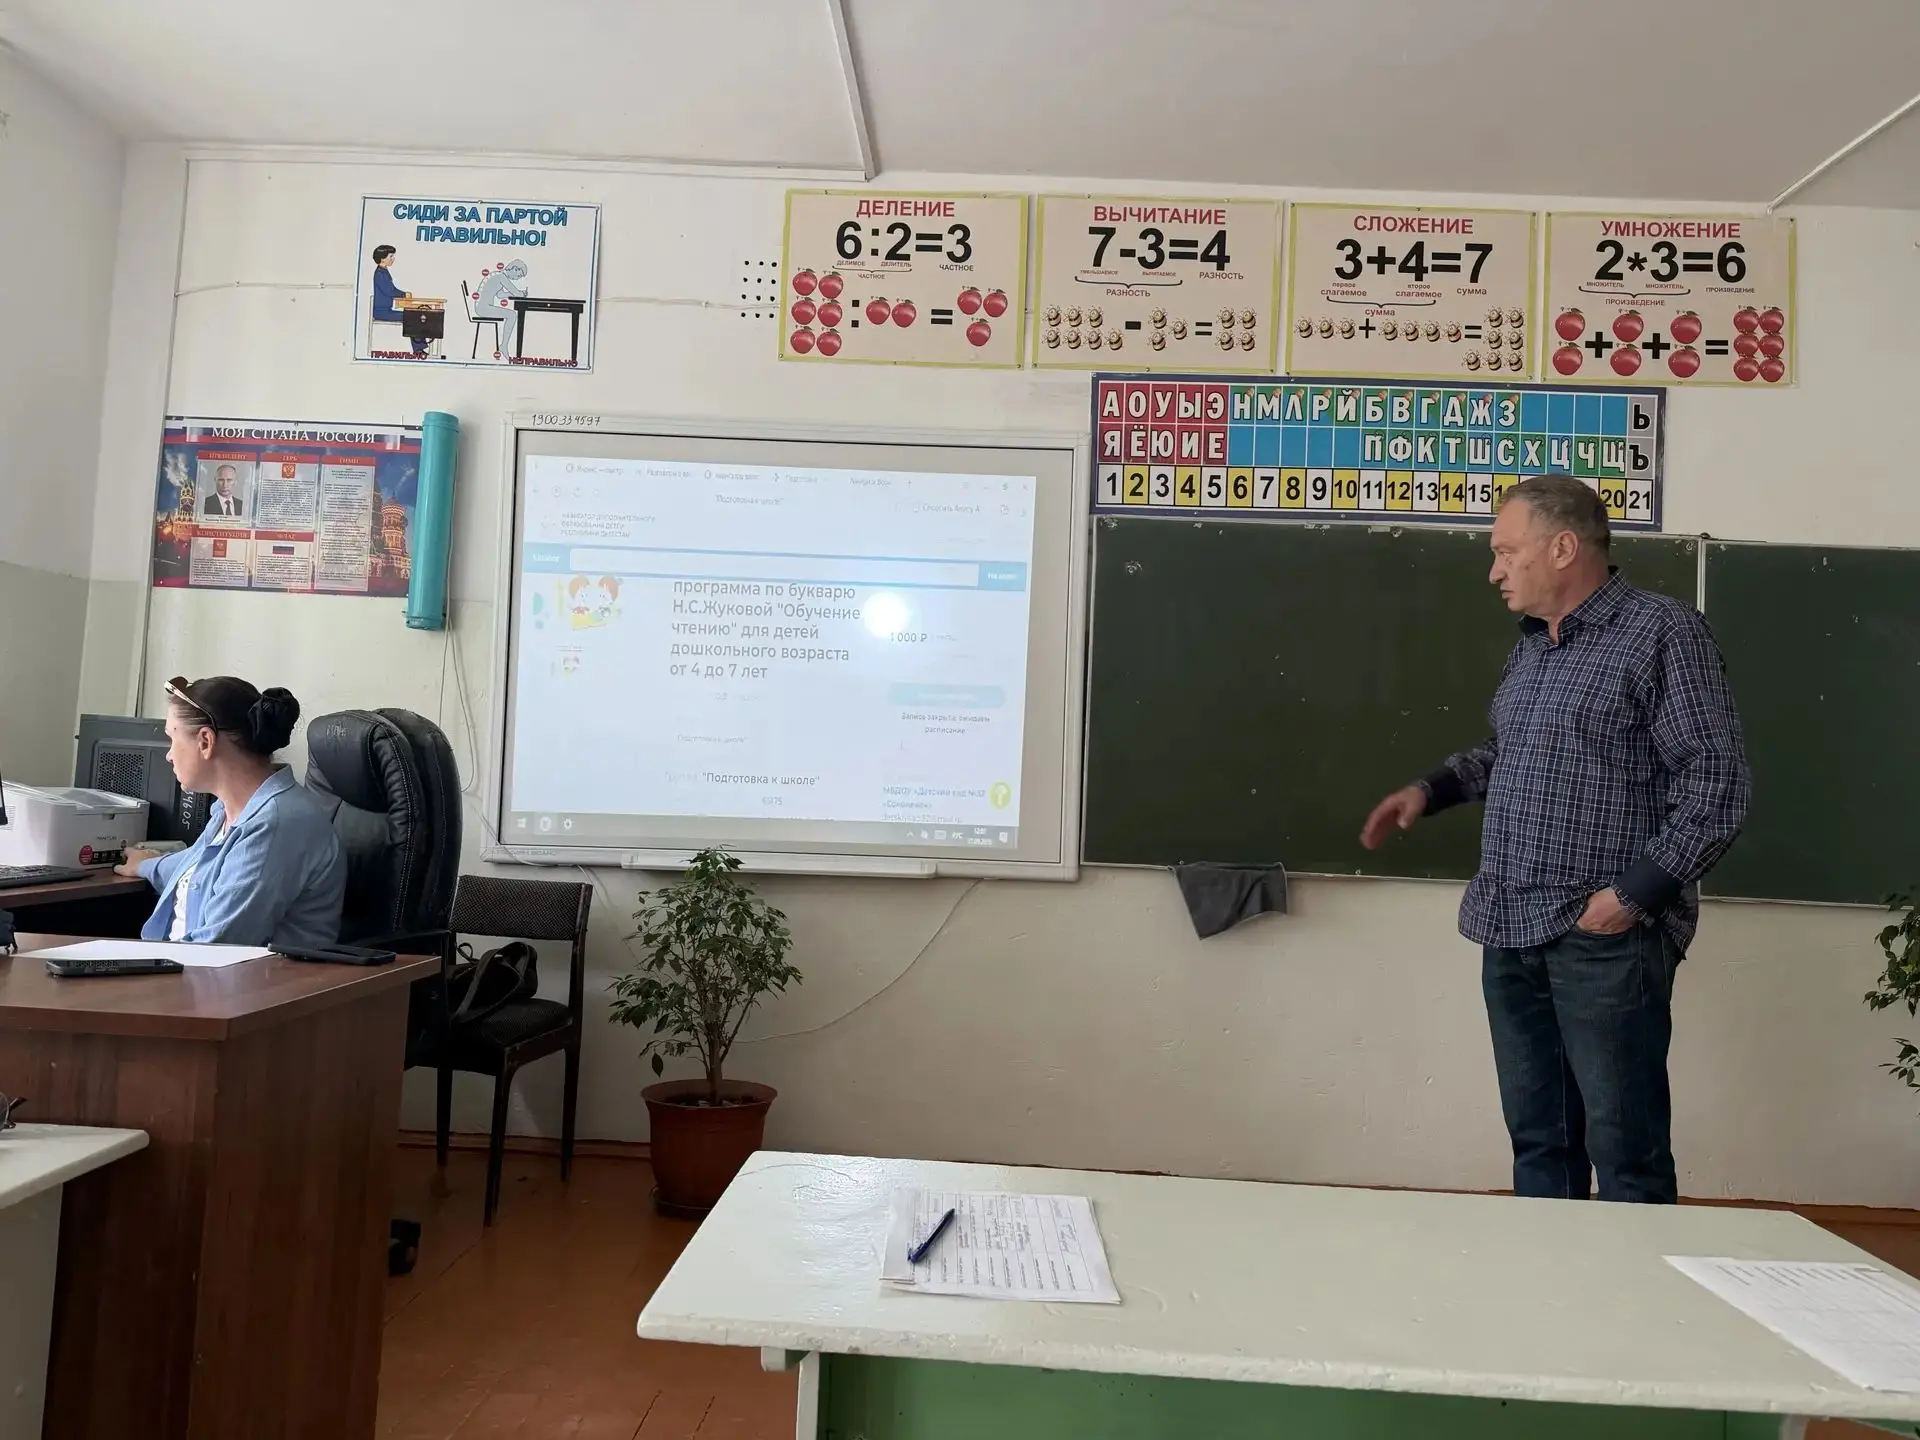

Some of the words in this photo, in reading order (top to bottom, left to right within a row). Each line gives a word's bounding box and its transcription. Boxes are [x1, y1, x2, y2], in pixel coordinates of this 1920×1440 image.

[393, 204, 448, 223] СИДИ
[454, 206, 480, 223] ЗА
[486, 207, 568, 226] ПАРТОЙ
[856, 200, 955, 218] ДЕЛЕНИЕ
[1094, 206, 1226, 225] ВЫЧИТАНИЕ
[1354, 215, 1474, 234] СЛОЖЕНИЕ
[1601, 220, 1740, 239] УМНОЖЕНИЕ
[416, 226, 547, 246] ПРАВИЛЬНО!
[1200, 272, 1244, 280] РАЗНОСТЬ
[1106, 289, 1151, 297] РАЗНОСТЬ
[1320, 288, 1367, 297] слагаемое
[1396, 290, 1442, 299] слагаемое
[1457, 288, 1487, 296] сумма
[1605, 298, 1665, 306] ПРОИЗВЕДЕНИЕ
[1365, 308, 1395, 316] сумма
[370, 351, 428, 361] ПРАВИЛЬНО
[509, 357, 578, 368] НЕПРАВИЛЬНО
[1102, 390, 1120, 418] А
[1128, 390, 1147, 418] О
[1155, 392, 1173, 418] У
[1178, 392, 1201, 419] Ы
[1207, 392, 1225, 419] Э
[1233, 393, 1251, 420] Н
[1256, 393, 1280, 420] М
[1284, 393, 1303, 421] Л
[1311, 393, 1329, 422] Р
[1336, 389, 1356, 422] Й
[1364, 396, 1384, 422] Б
[1392, 396, 1410, 423] В
[1420, 397, 1436, 424] Г
[1443, 396, 1464, 427] Д
[1470, 398, 1492, 426] Ж
[1498, 400, 1516, 427] З
[1633, 404, 1651, 430] Ь
[212, 427, 246, 439] МОЯ
[251, 429, 309, 441] СТРАНА
[316, 431, 376, 443] РОССИЯ
[1103, 431, 1121, 457] Я
[1130, 424, 1147, 457] Ё
[1151, 431, 1174, 457] Ю
[1181, 432, 1200, 459] И
[1208, 432, 1224, 459] Е
[1364, 433, 1382, 461] П
[1388, 436, 1412, 462] Ф
[1417, 437, 1436, 464] К
[1444, 437, 1461, 464] Т
[1469, 437, 1491, 465] Ш
[1497, 439, 1516, 466] С
[1523, 439, 1542, 467] Х
[1551, 440, 1570, 470] Ц
[1577, 440, 1595, 469] Ч
[1602, 441, 1625, 473] Щ
[1629, 444, 1649, 470] Ъ
[1106, 473, 1117, 496] 1
[1129, 473, 1143, 497] 2
[1155, 474, 1169, 497] 3
[1180, 475, 1195, 498] 4
[1207, 475, 1221, 498] 5
[1233, 475, 1247, 499] 6
[1260, 476, 1275, 499] 7
[1286, 476, 1300, 500] 8
[1312, 477, 1327, 500] 9
[1334, 480, 1357, 499] 10
[1363, 481, 1382, 499] 11
[1387, 482, 1410, 500] 12
[1415, 482, 1438, 501] 13
[1442, 483, 1464, 501] 14
[1468, 484, 1491, 503] 15
[1603, 489, 1624, 508] 20
[1629, 490, 1650, 510] 21
[674, 581, 760, 595] программа
[765, 584, 784, 596] по
[788, 583, 856, 601] букварю
[673, 599, 773, 618] Н.С.Жуковой
[778, 602, 860, 621] "Обучение
[672, 621, 737, 636] чтению"
[741, 624, 769, 638] для
[773, 624, 819, 639] детей
[670, 643, 776, 658] дошкольного
[781, 647, 849, 662] возраста
[670, 664, 686, 675] от
[691, 663, 700, 676] 4
[704, 665, 724, 679] до
[728, 664, 737, 676] 7
[741, 667, 768, 678] лет
[702, 772, 768, 784] "Подготовка
[772, 776, 778, 784] к
[781, 776, 820, 785] школе"
